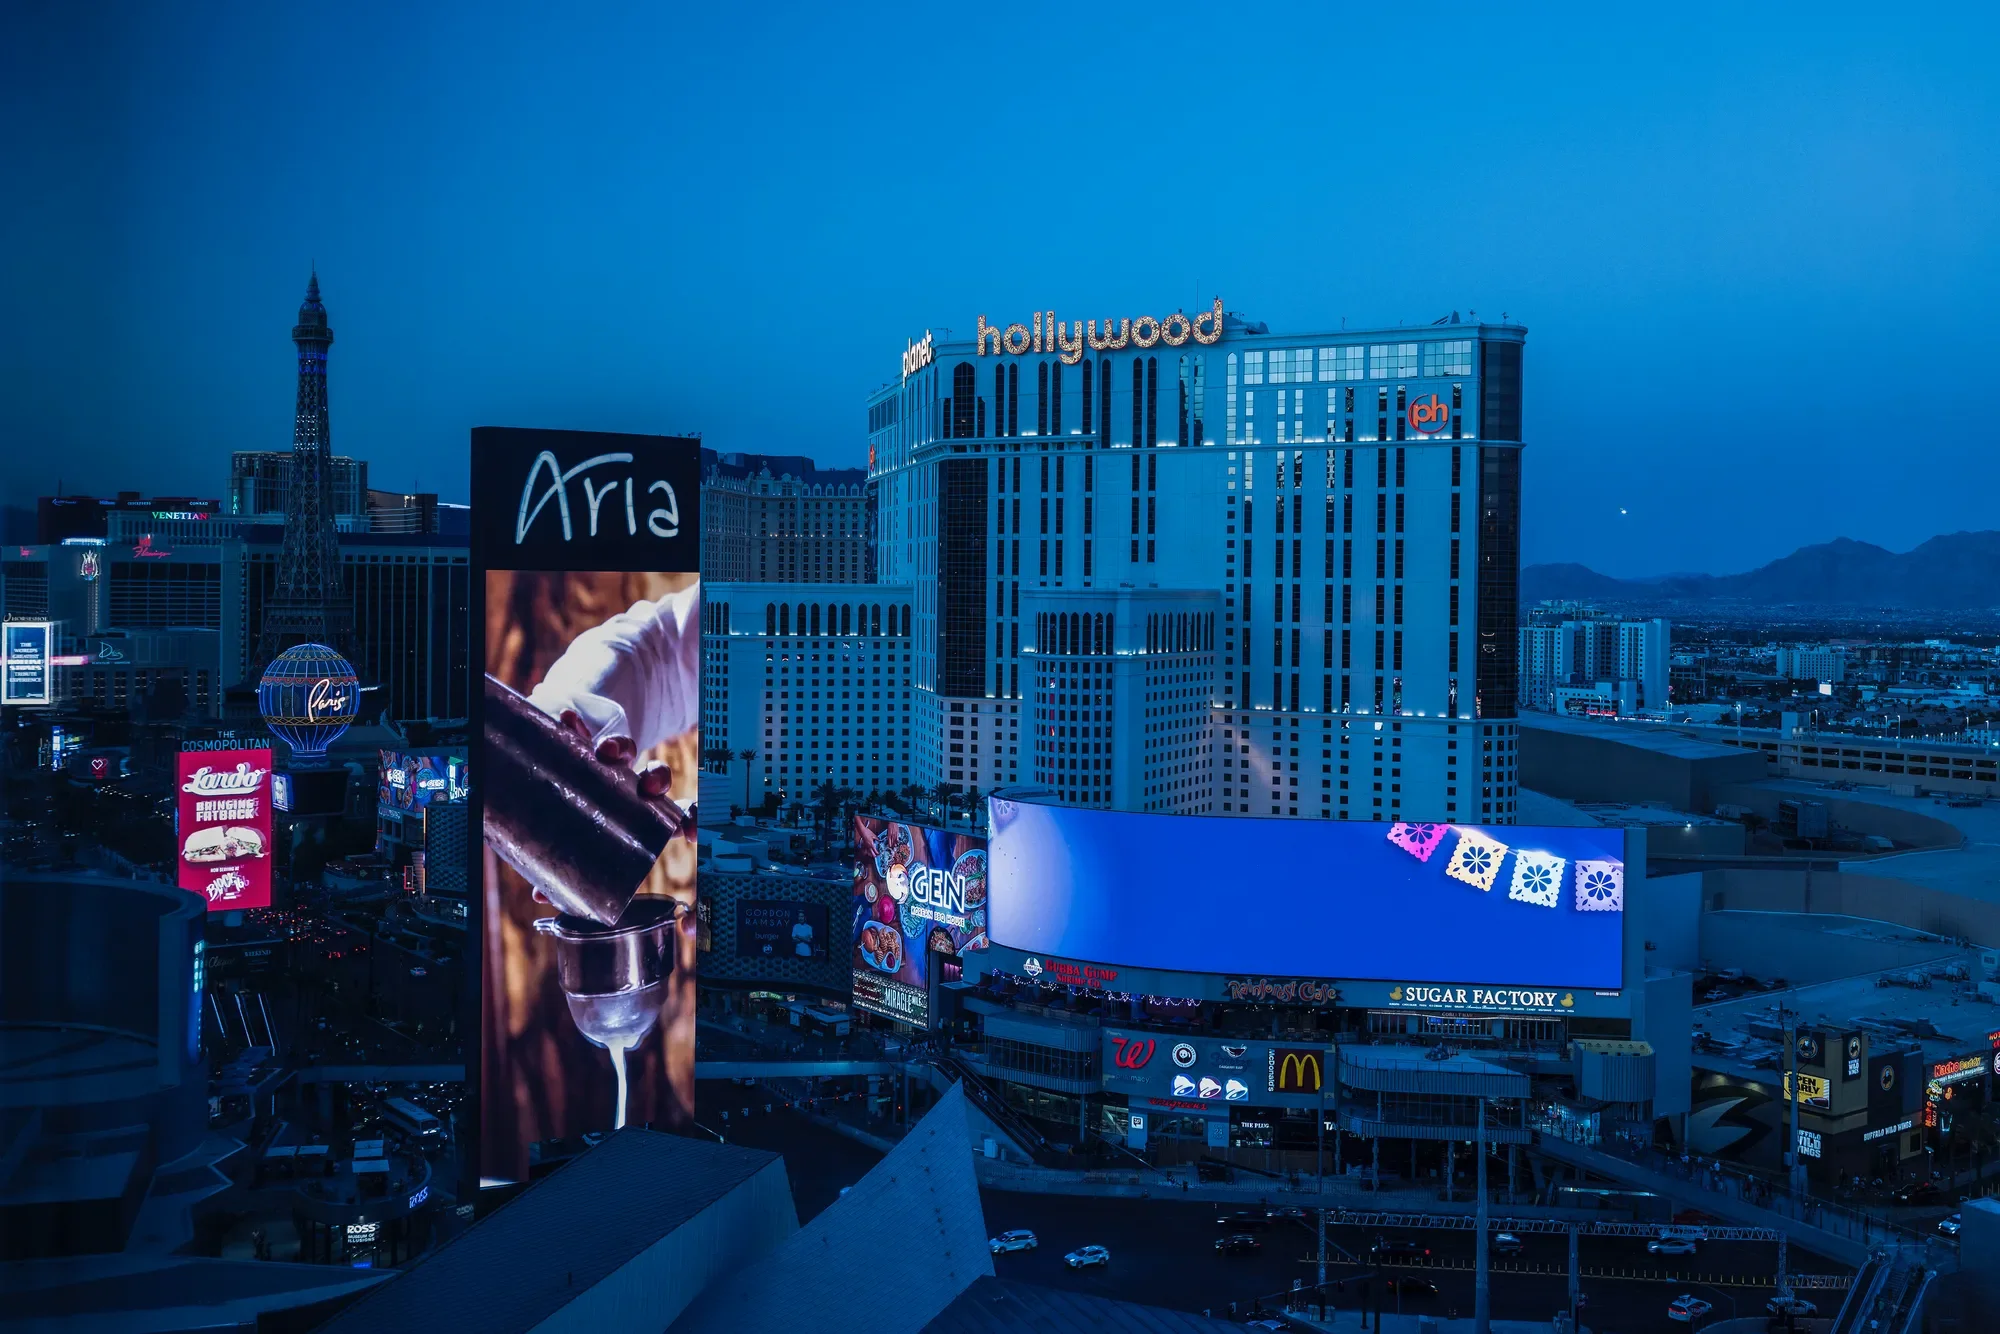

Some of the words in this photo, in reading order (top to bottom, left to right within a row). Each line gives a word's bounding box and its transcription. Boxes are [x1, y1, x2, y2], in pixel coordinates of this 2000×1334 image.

[977, 299, 1223, 365] hollywood
[902, 329, 932, 388] planet
[1413, 394, 1448, 428] ph
[515, 450, 679, 545] Aria
[152, 512, 208, 520] VENETIAN
[308, 679, 345, 723] Paris
[181, 738, 270, 752] COSMOPOLITAN
[218, 731, 235, 739] THE
[181, 762, 266, 796] Lardo
[196, 799, 256, 812] BRINGING
[196, 808, 255, 822] FATBACK
[910, 866, 965, 914] GEN
[745, 909, 790, 918] GORDON
[745, 919, 790, 927] RAMSAY
[911, 906, 933, 920] KOREAN
[934, 911, 945, 923] BBQ
[946, 914, 965, 927] HOUSE
[755, 932, 779, 941] burger
[884, 988, 912, 1013] MIRACLE
[1228, 979, 1297, 1002] Rainforest
[1406, 987, 1468, 1003] SUGAR
[1472, 989, 1557, 1007] FACTORY
[1934, 1061, 1960, 1078] Nacho
[1148, 1097, 1208, 1110] Walgreens
[1863, 1128, 1885, 1141] BUFFALO
[1885, 1125, 1897, 1135] WILD
[1897, 1120, 1912, 1132] WINGS
[409, 1186, 429, 1208] ROSS
[347, 1223, 376, 1234] ROSS
